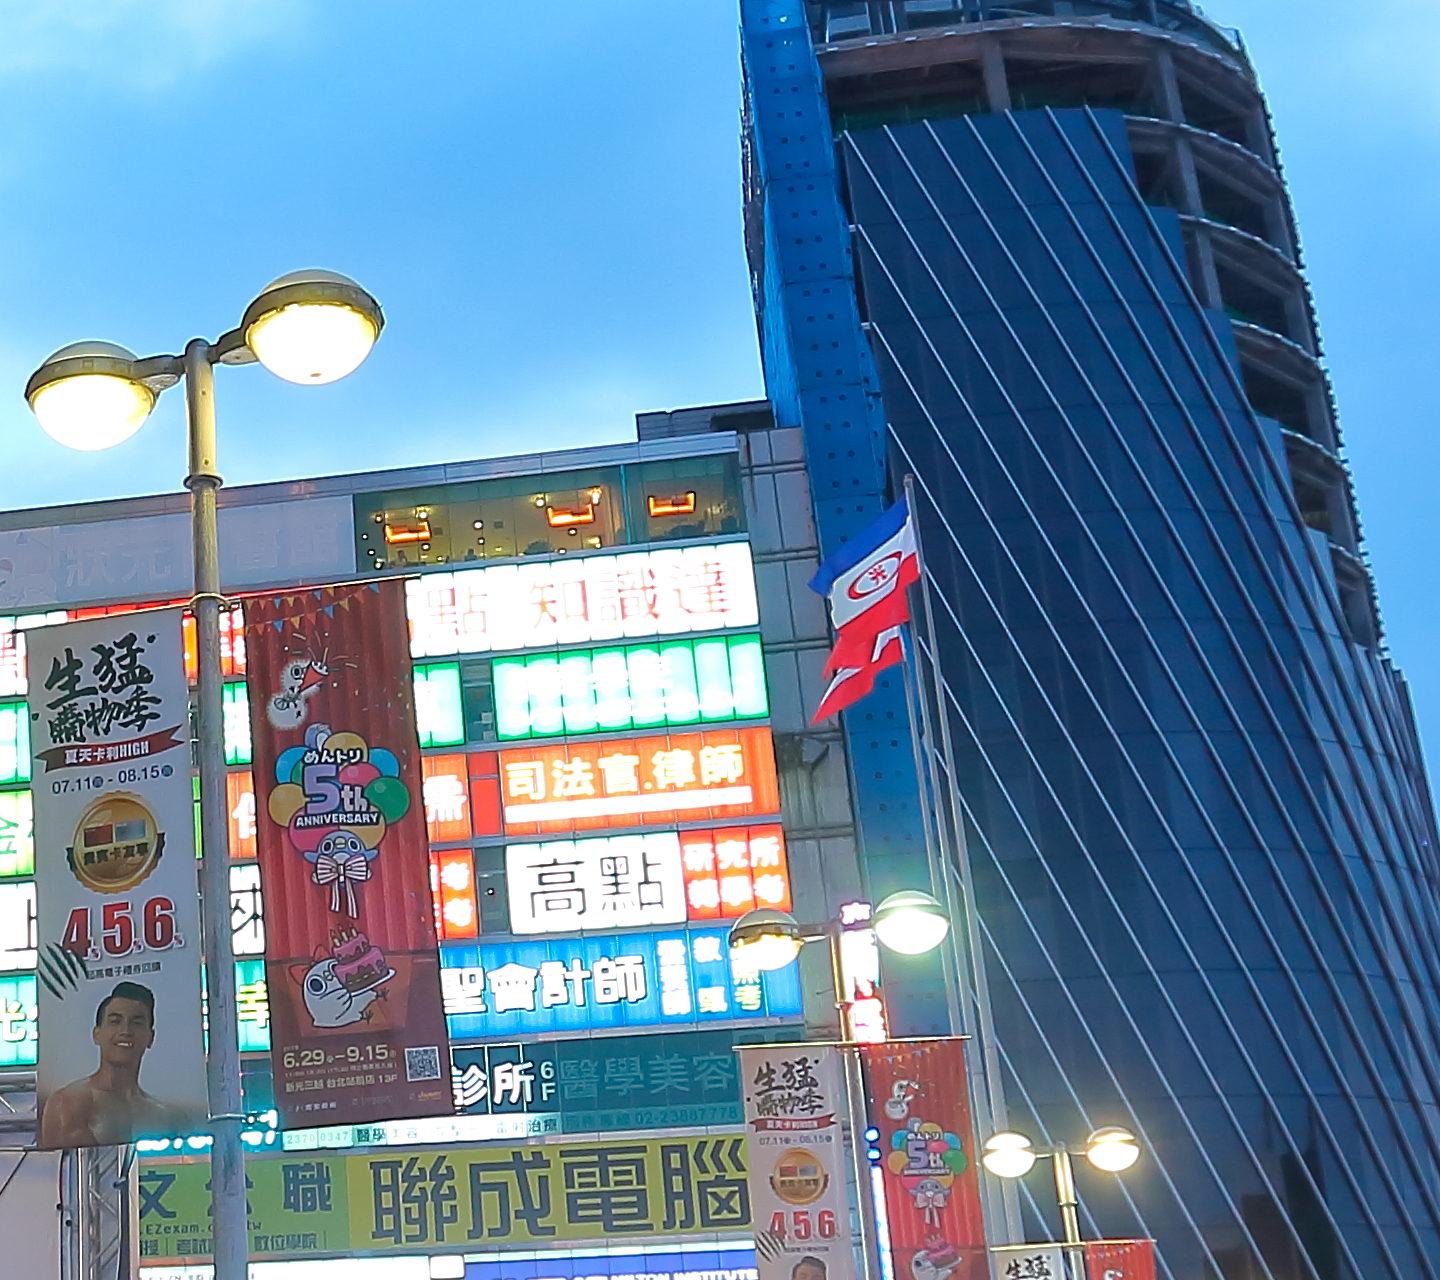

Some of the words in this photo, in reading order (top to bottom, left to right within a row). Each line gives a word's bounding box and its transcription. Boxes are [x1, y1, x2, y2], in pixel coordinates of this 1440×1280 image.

[44, 632, 154, 710] 生猛
[303, 749, 363, 765] めんトリ
[504, 744, 744, 802] 司法官.律師
[303, 765, 368, 815] 5th
[296, 812, 379, 828] ANNIVERSARY
[526, 851, 664, 919] 高點
[560, 1050, 735, 1100] 醫學美容
[754, 1056, 819, 1096] 生猛
[369, 1138, 753, 1245] 聯成電腦
